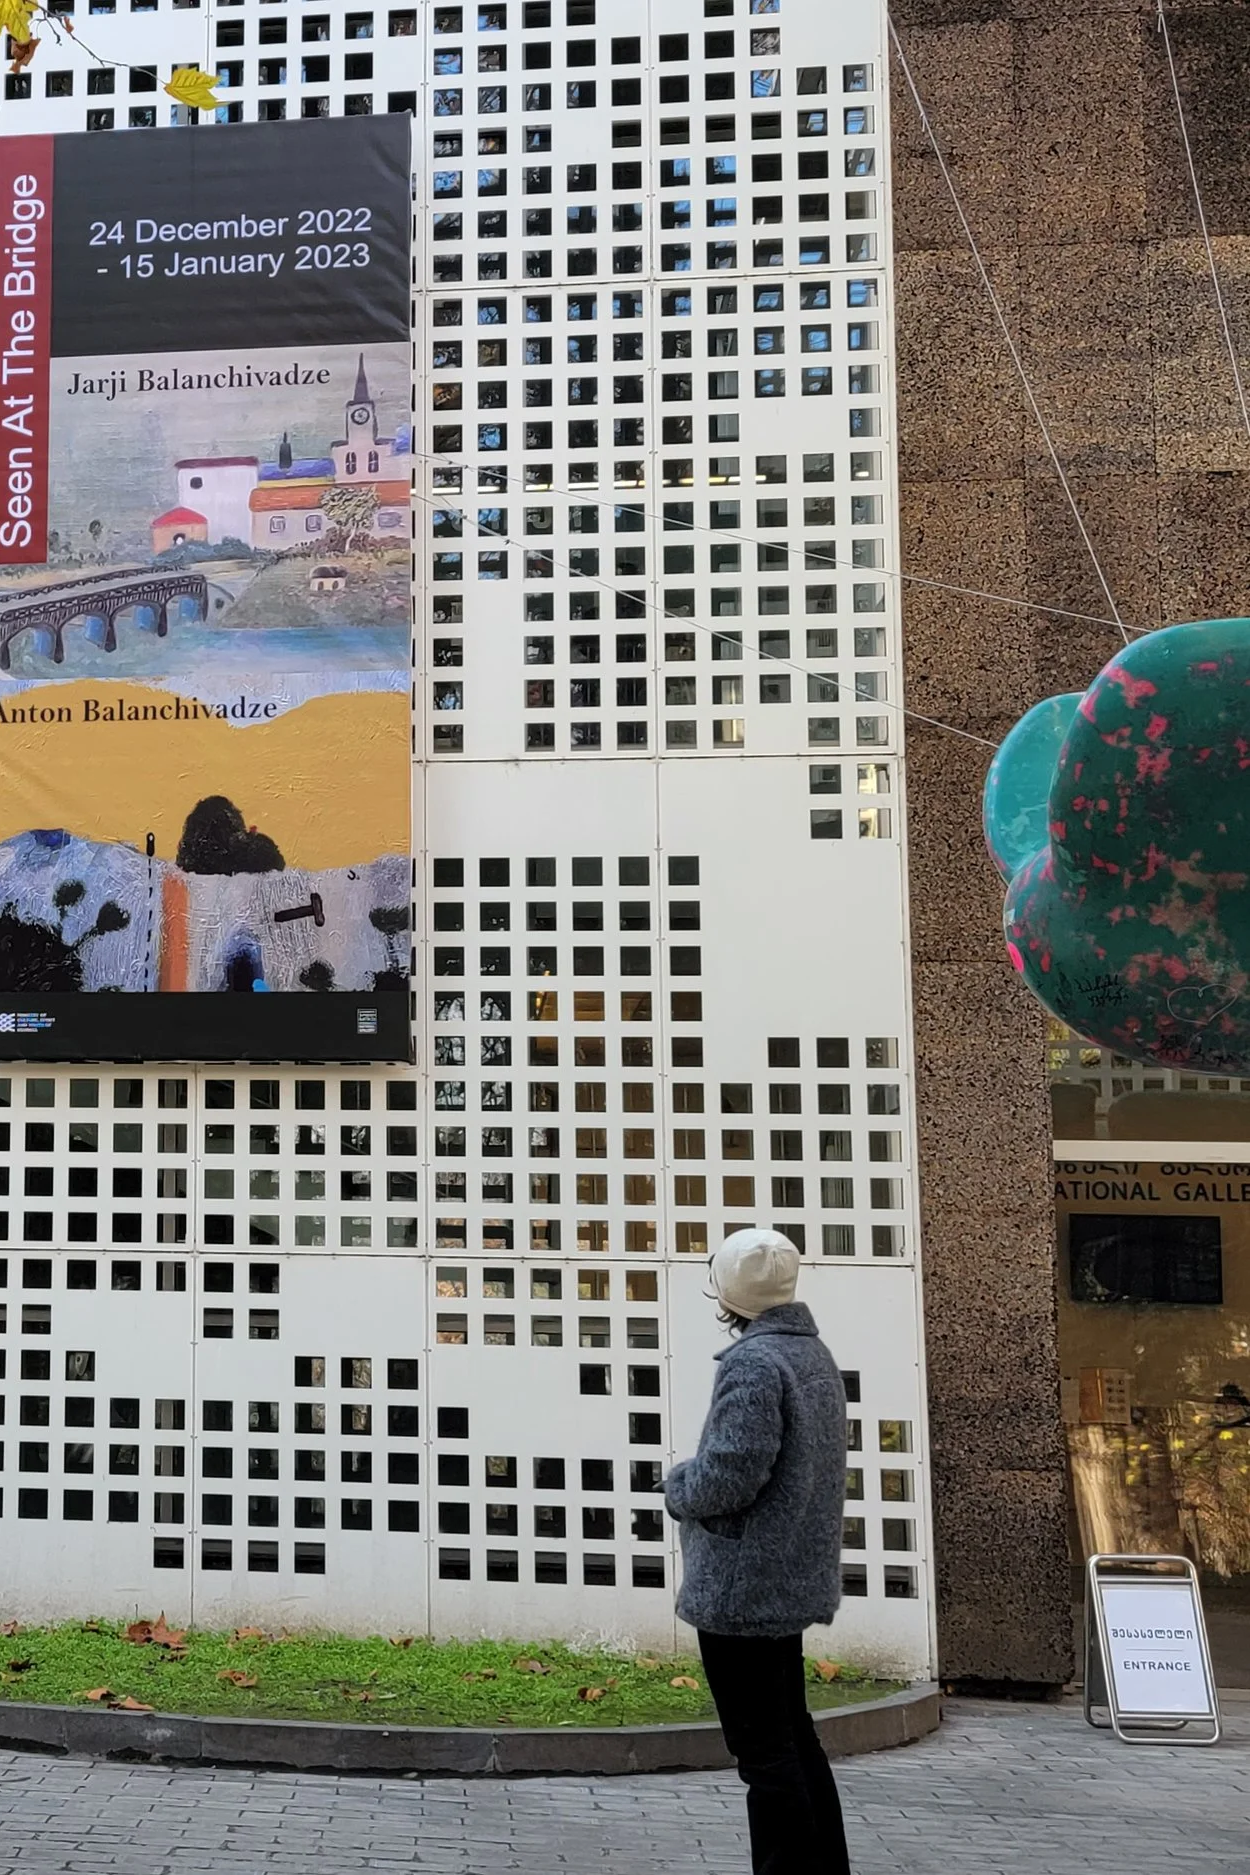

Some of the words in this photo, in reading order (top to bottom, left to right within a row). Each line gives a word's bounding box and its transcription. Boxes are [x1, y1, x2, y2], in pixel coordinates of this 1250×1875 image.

[2, 174, 46, 297] Bridge
[89, 221, 125, 246] 24
[136, 213, 290, 243] December
[297, 207, 372, 236] 2022
[120, 253, 154, 279] 15
[164, 248, 285, 279] January
[294, 242, 370, 270] 2023
[1, 309, 36, 386] The
[67, 369, 127, 401] Jarji
[138, 363, 331, 393] Balanchivadze
[1, 394, 35, 437] At
[0, 446, 34, 549] Seen
[82, 696, 278, 723] Balanchivadze
[1111, 1628, 1194, 1640] შესასვლელი
[1123, 1660, 1192, 1672] ENTRANCE
